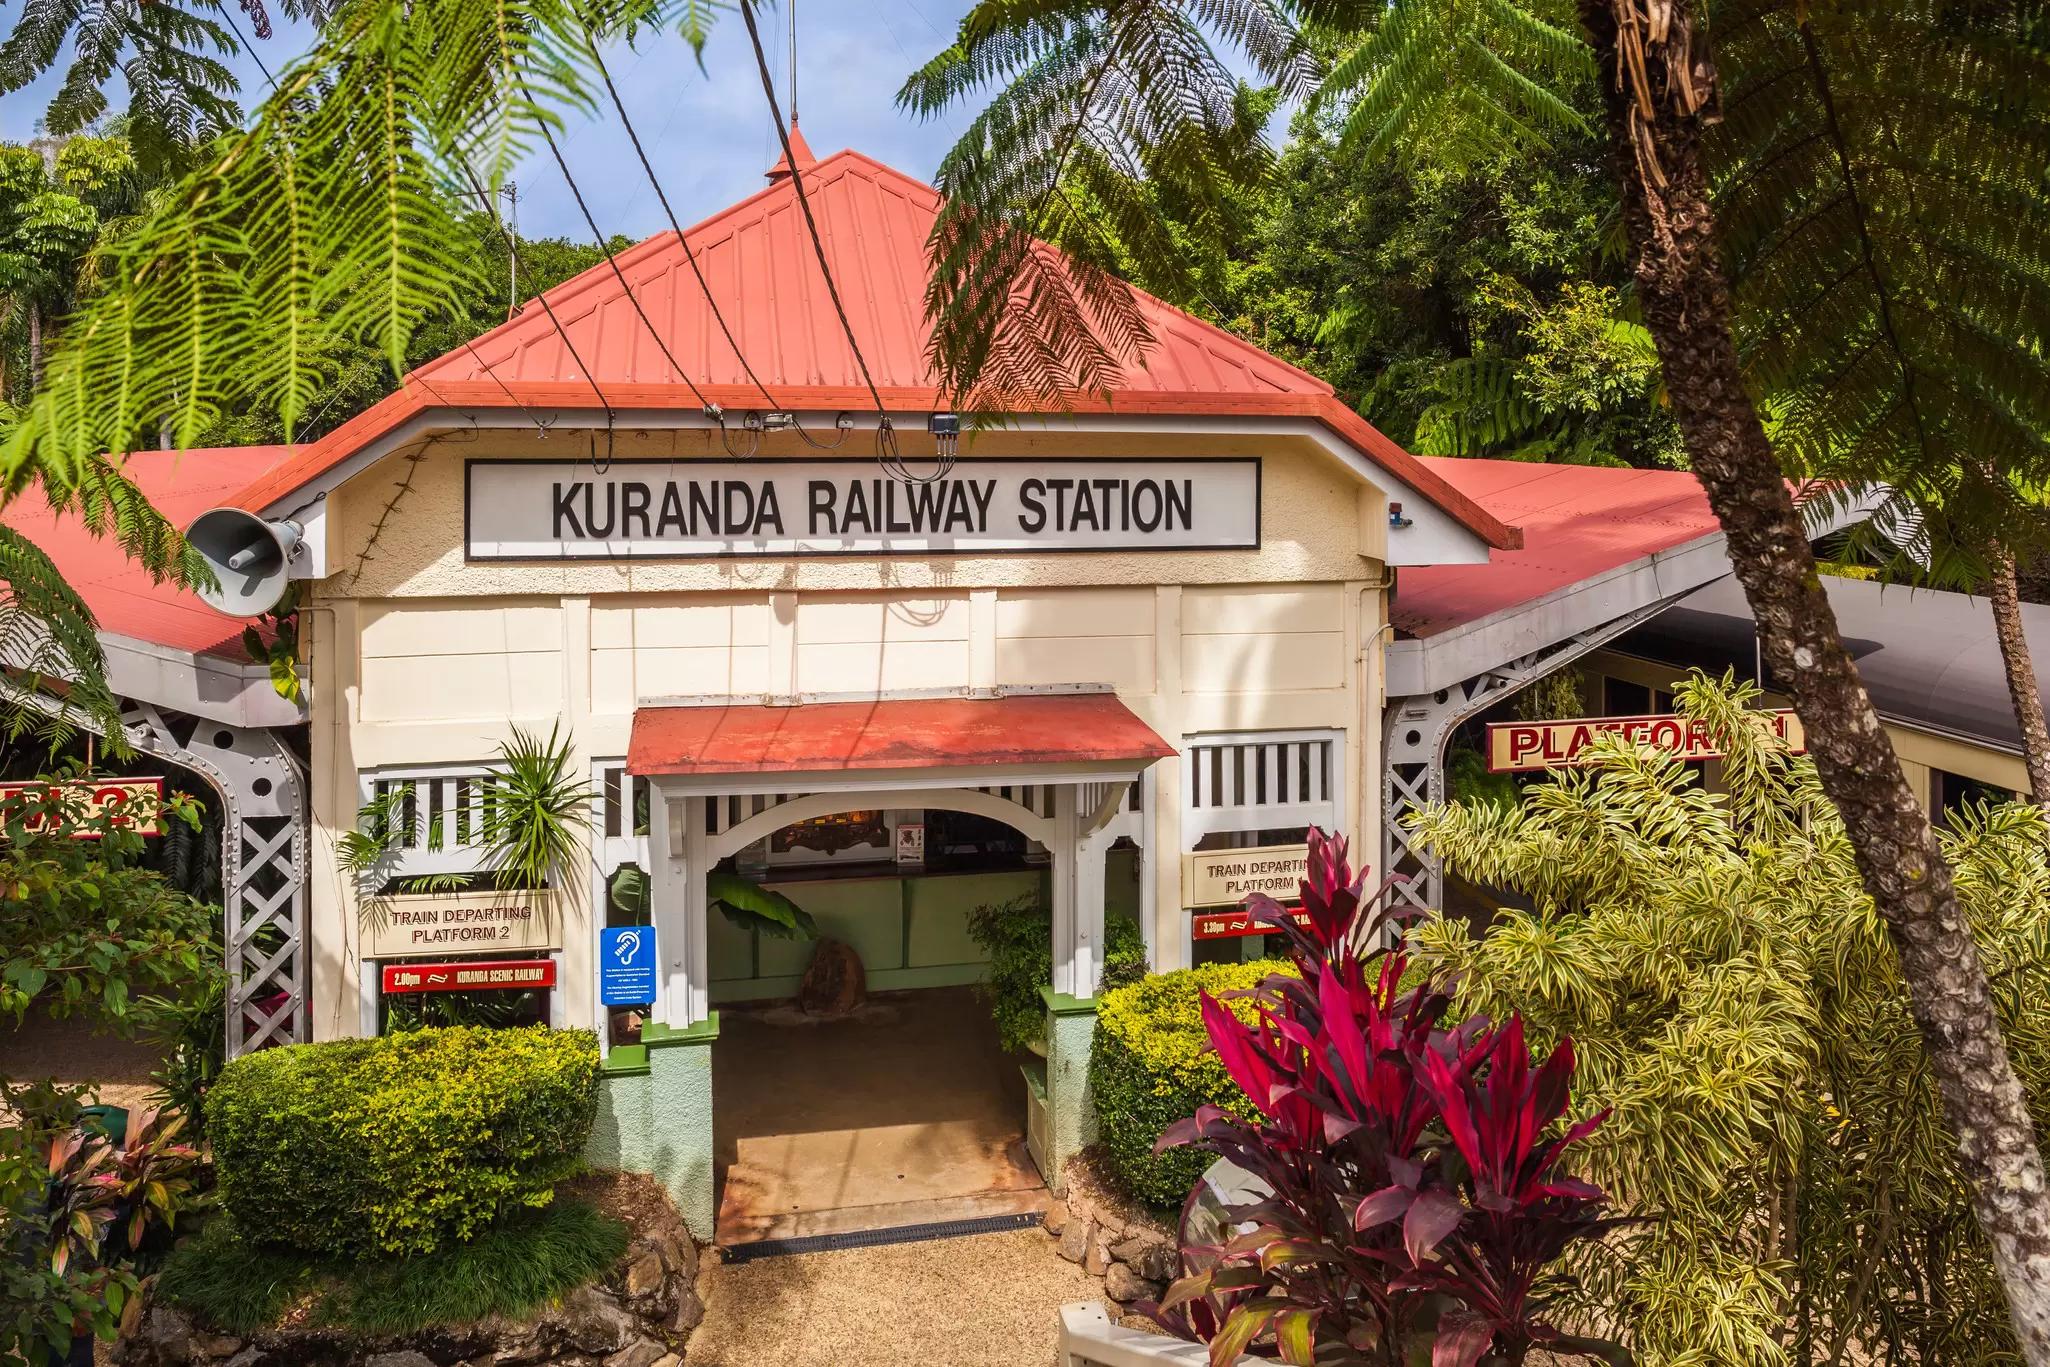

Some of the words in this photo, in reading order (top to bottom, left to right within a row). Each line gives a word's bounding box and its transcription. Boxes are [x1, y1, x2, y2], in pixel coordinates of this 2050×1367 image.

[553, 480, 784, 539] KURANDA
[808, 479, 997, 535] RAILWAY
[1018, 478, 1192, 533] STATION
[1510, 717, 1750, 764] PLATFOR
[93, 787, 134, 830] 2
[1207, 864, 1247, 877] TRAIN
[1225, 877, 1294, 893] PLATFORM
[391, 910, 439, 925] TRAIN
[443, 906, 532, 924] DEPARTING
[412, 927, 497, 944] PLATFORM
[499, 926, 510, 940] 2
[1204, 922, 1224, 933] 3.30pm
[394, 972, 421, 987] 2.00pm
[457, 970, 488, 983] KURANDA
[490, 968, 513, 982] SCENIC
[514, 967, 544, 981] RAILWAY
